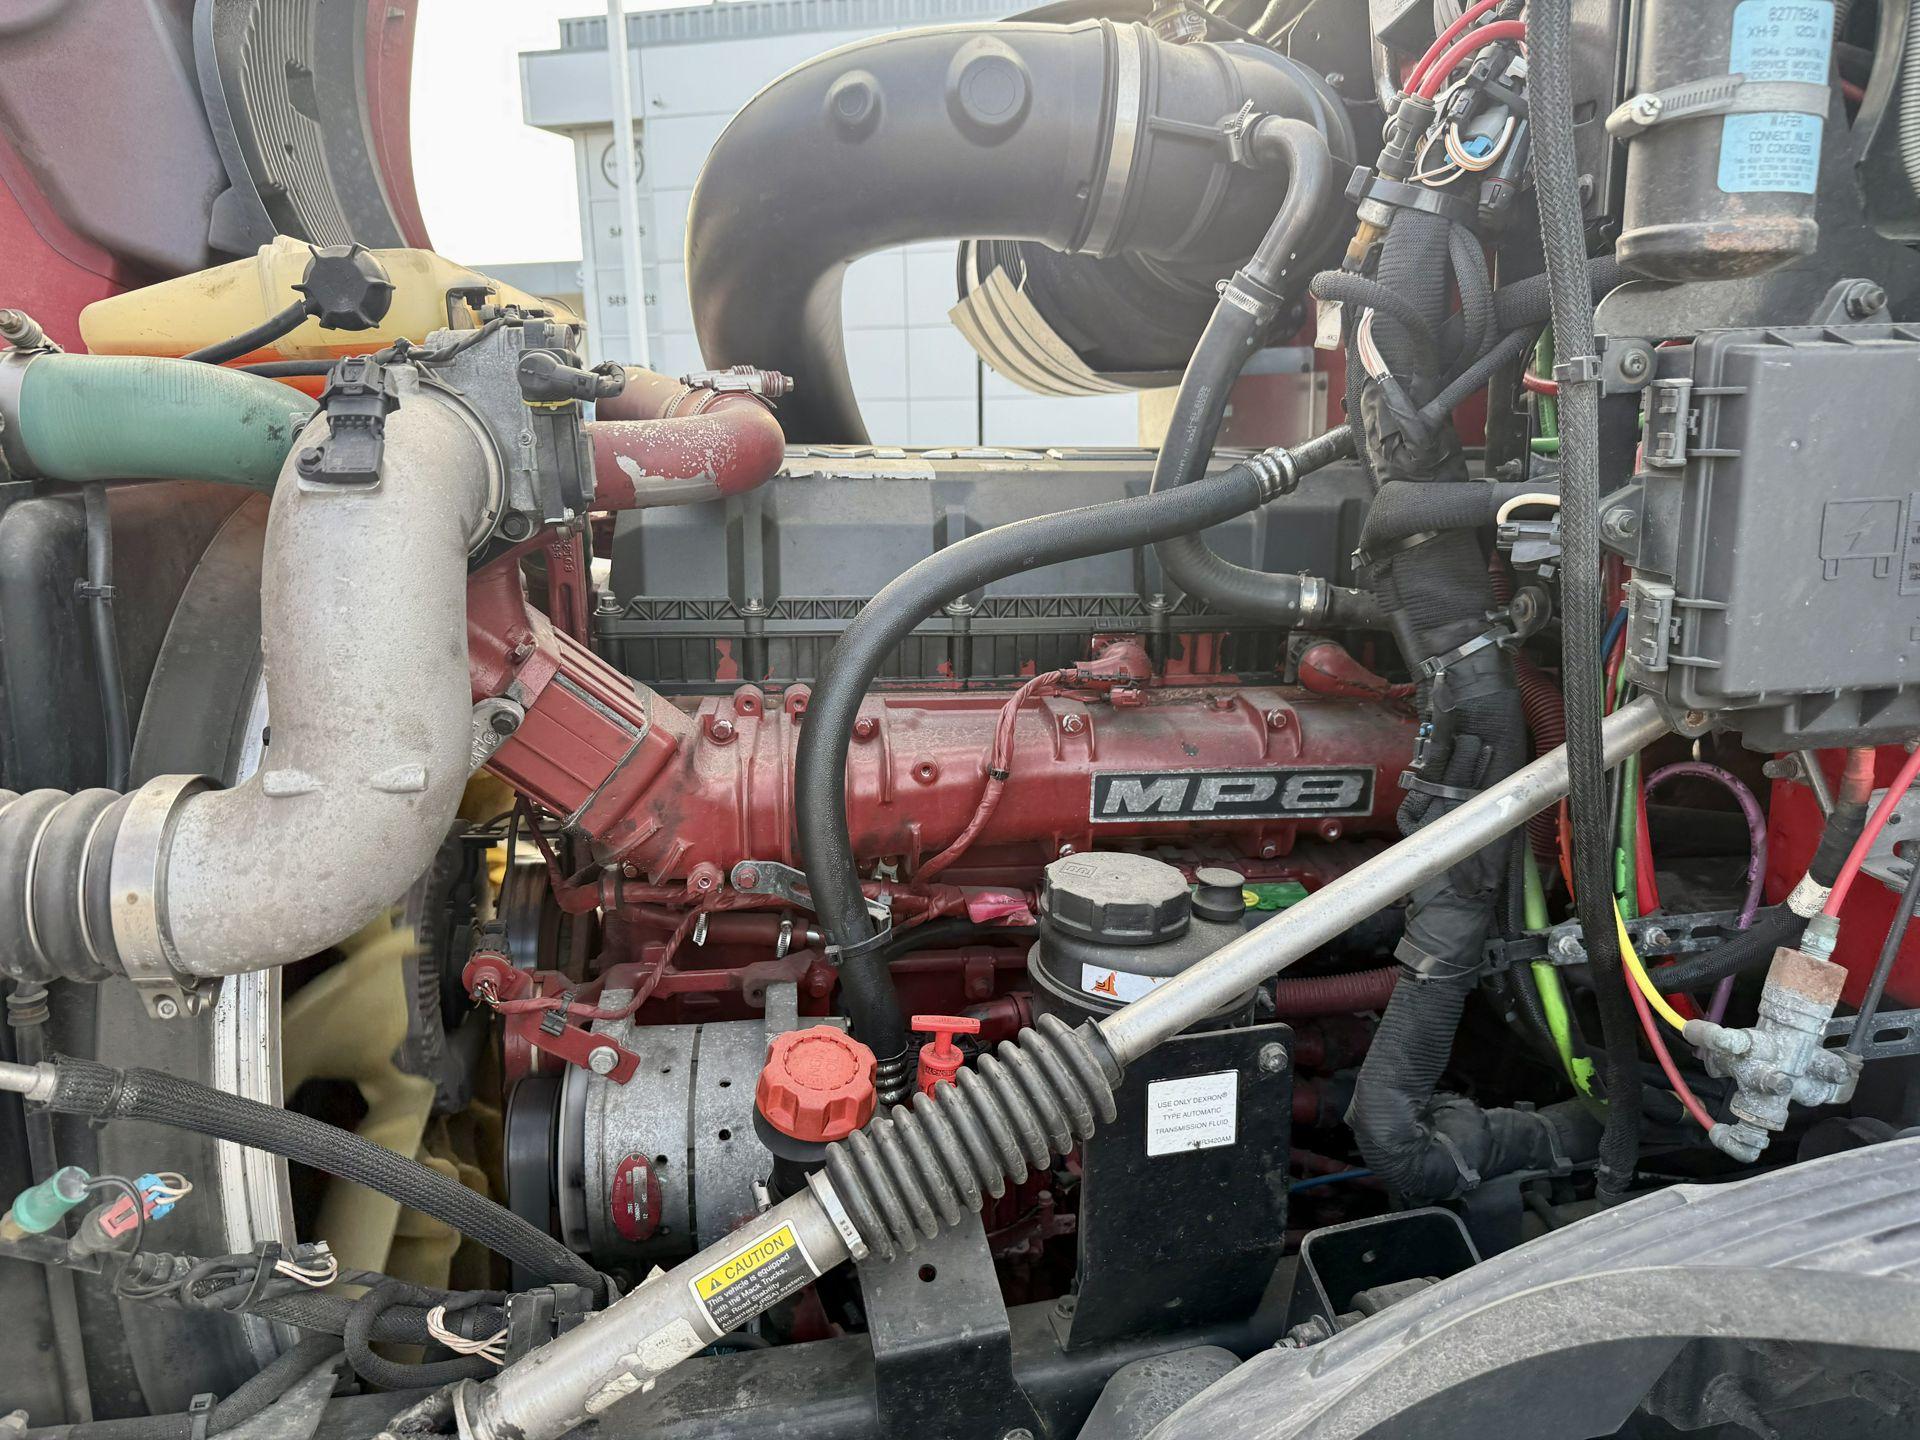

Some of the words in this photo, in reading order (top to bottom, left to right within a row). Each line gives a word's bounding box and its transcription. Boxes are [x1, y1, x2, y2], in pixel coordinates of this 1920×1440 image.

[1749, 130, 1792, 142] CONNECT
[1749, 143, 1762, 154] TO
[609, 226, 646, 238] SAS
[608, 295, 657, 306] SERCE
[1102, 774, 1365, 814] MP8
[1157, 1100, 1172, 1108] USE
[1173, 1098, 1192, 1106] ONLY
[1163, 1112, 1181, 1120] TYPE
[1183, 1107, 1222, 1117] AUTOMATIC
[1155, 1122, 1207, 1134] TRANSMISSION
[1209, 1119, 1229, 1127] FLUID
[725, 1235, 785, 1280] CAUTION
[707, 1295, 724, 1307] This
[724, 1278, 749, 1297] vehicle
[749, 1275, 757, 1283] is
[757, 1252, 791, 1278] equipped
[780, 1274, 807, 1293] system.
[713, 1303, 729, 1316] with
[729, 1296, 741, 1307] the
[741, 1284, 762, 1299] Mack
[717, 1311, 732, 1323] Inc.
[731, 1301, 751, 1314] Road
[751, 1281, 781, 1302] Stability
